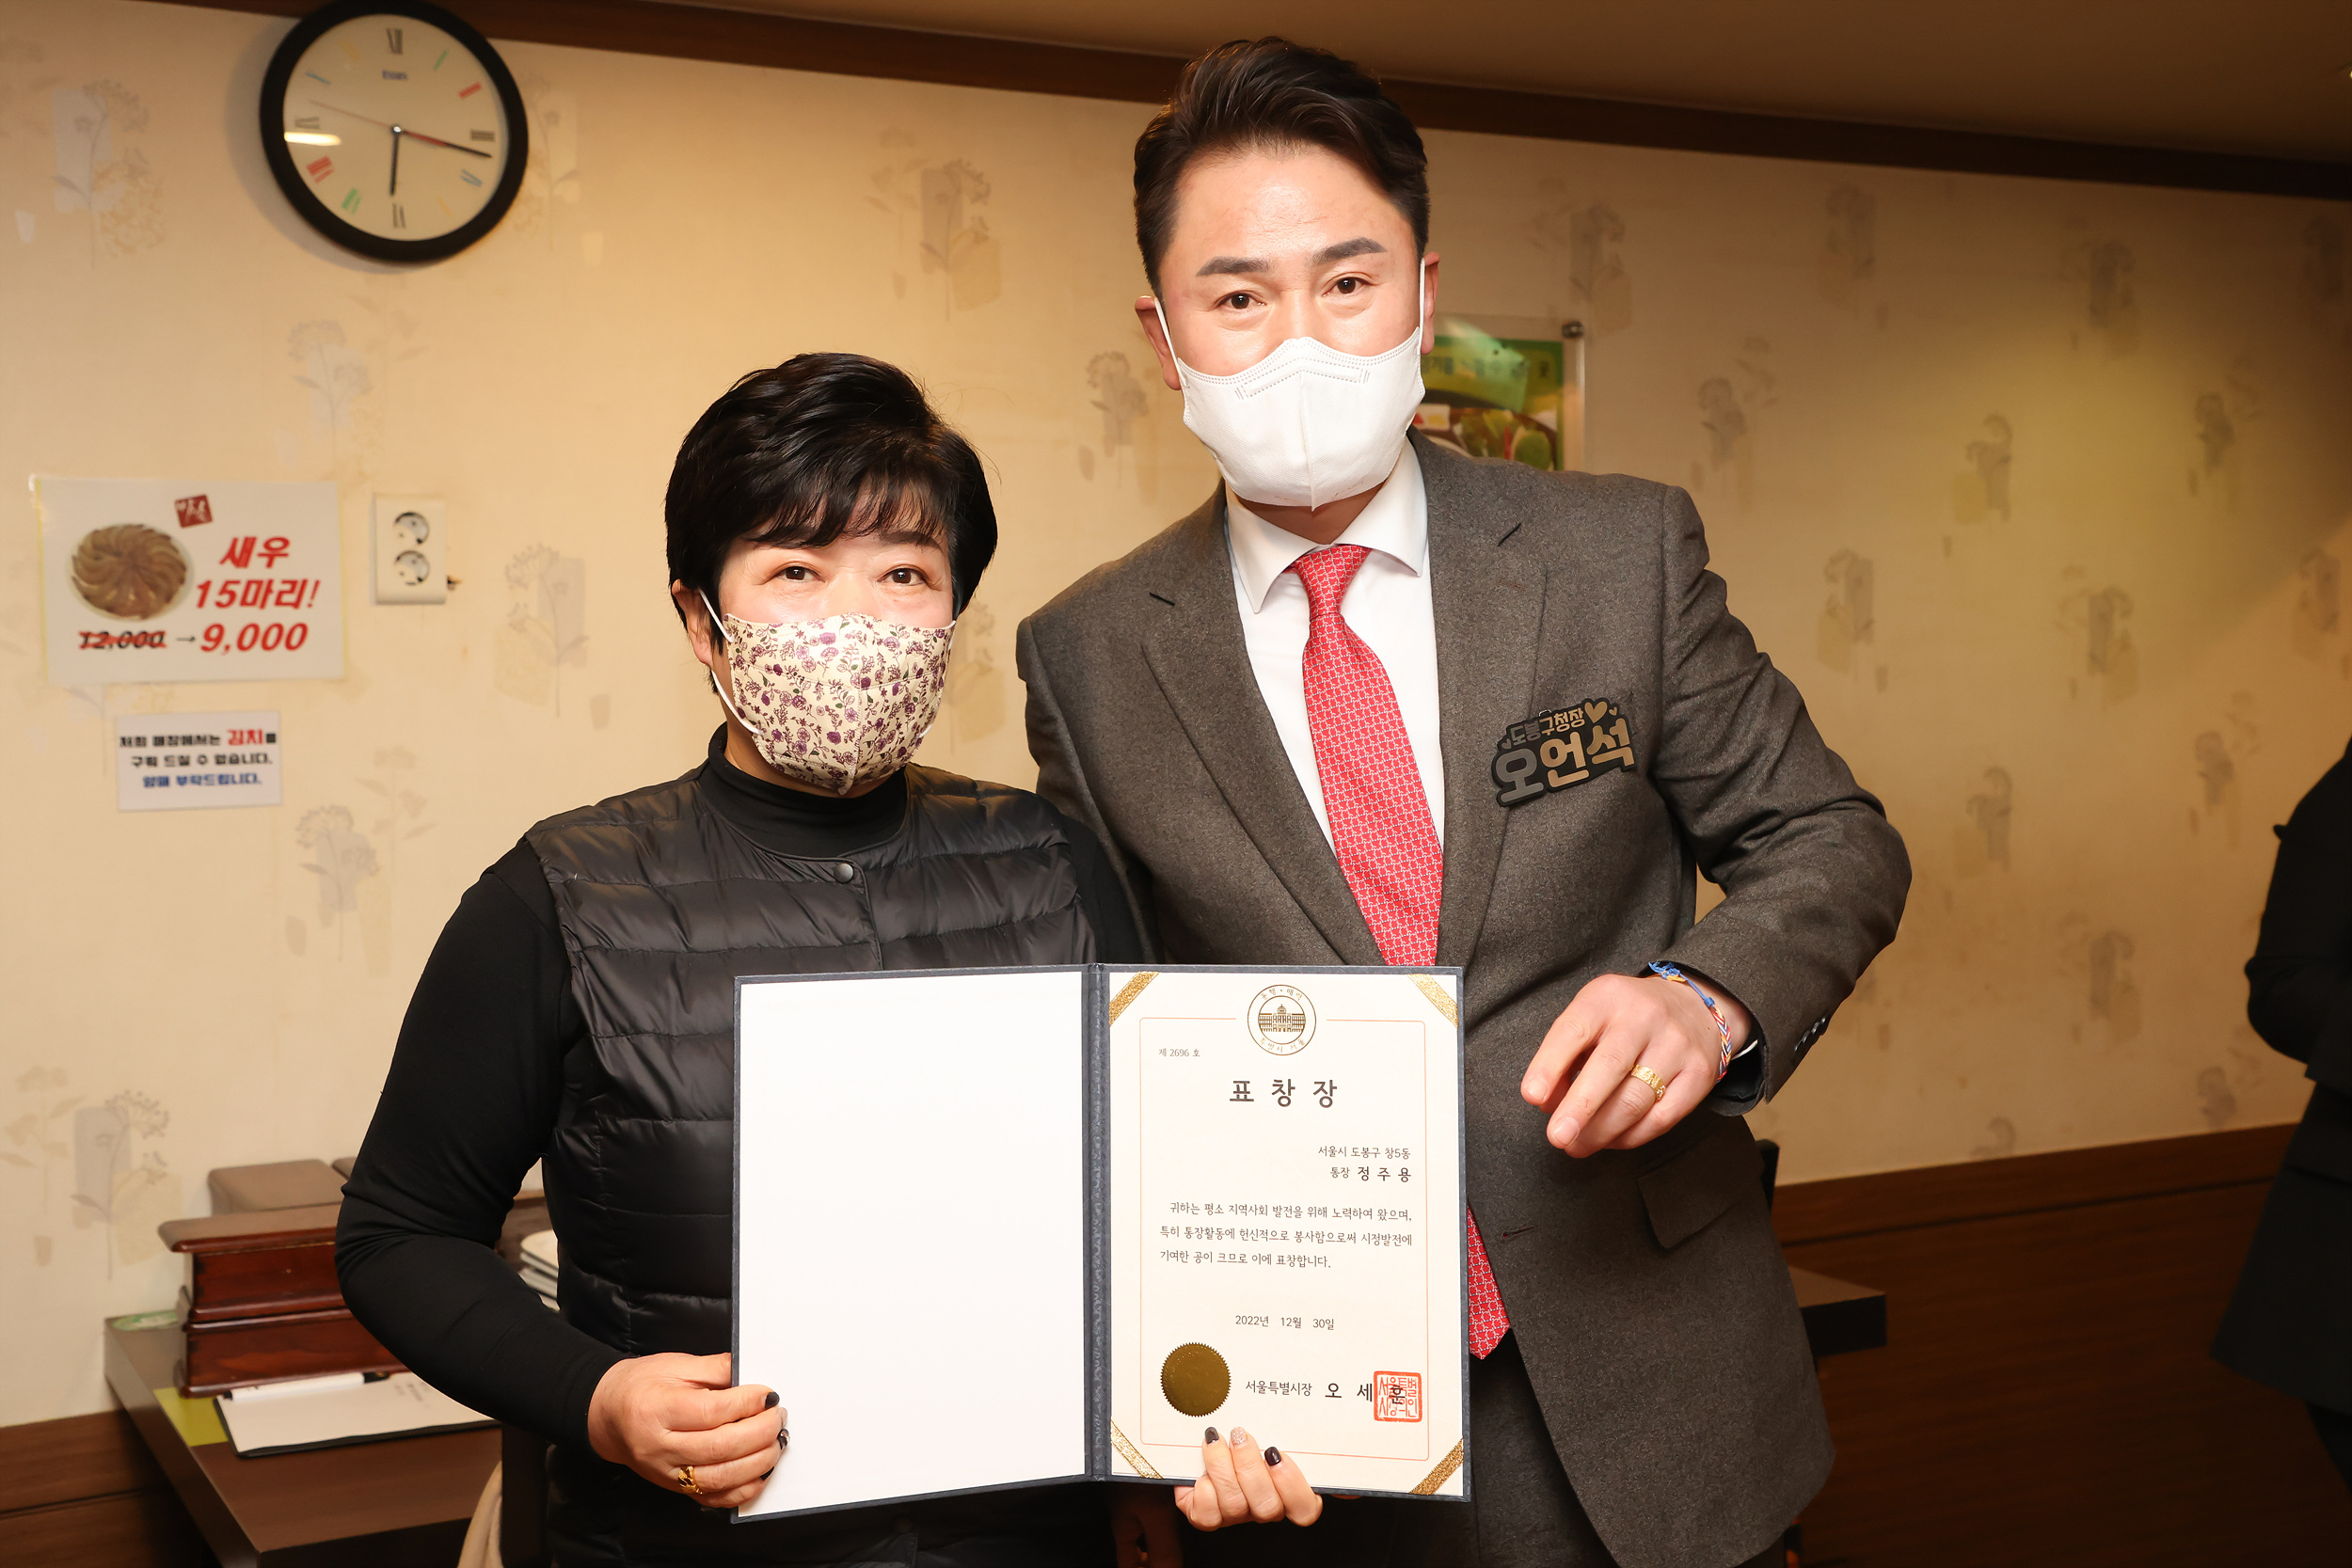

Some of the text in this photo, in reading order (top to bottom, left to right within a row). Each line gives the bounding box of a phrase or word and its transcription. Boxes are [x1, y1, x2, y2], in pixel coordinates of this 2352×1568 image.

[219, 536, 290, 568] 새우
[197, 578, 320, 610] 15마리!
[200, 623, 308, 656] 9,000
[1509, 707, 1585, 747] 도봉구청장
[1495, 718, 1635, 803] 오언석
[1158, 1047, 1201, 1057] 제 2696 호
[1317, 1145, 1411, 1161] 서울시 도봉구 창5동
[1329, 1166, 1351, 1180] 통장
[1169, 1201, 1412, 1222] 귀하는 평소 지역사회 발전을 위해 노력하여 왔으며,
[1159, 1226, 1412, 1247] 특히 통장활동에 헌신적으로 봉사함으로써 시정발전에
[1160, 1249, 1331, 1269] 기여한 공이 크므로 이에 표창합니다.
[1234, 1314, 1334, 1331] 2022년 12월 30일
[1245, 1380, 1313, 1397] 서울특별시장
